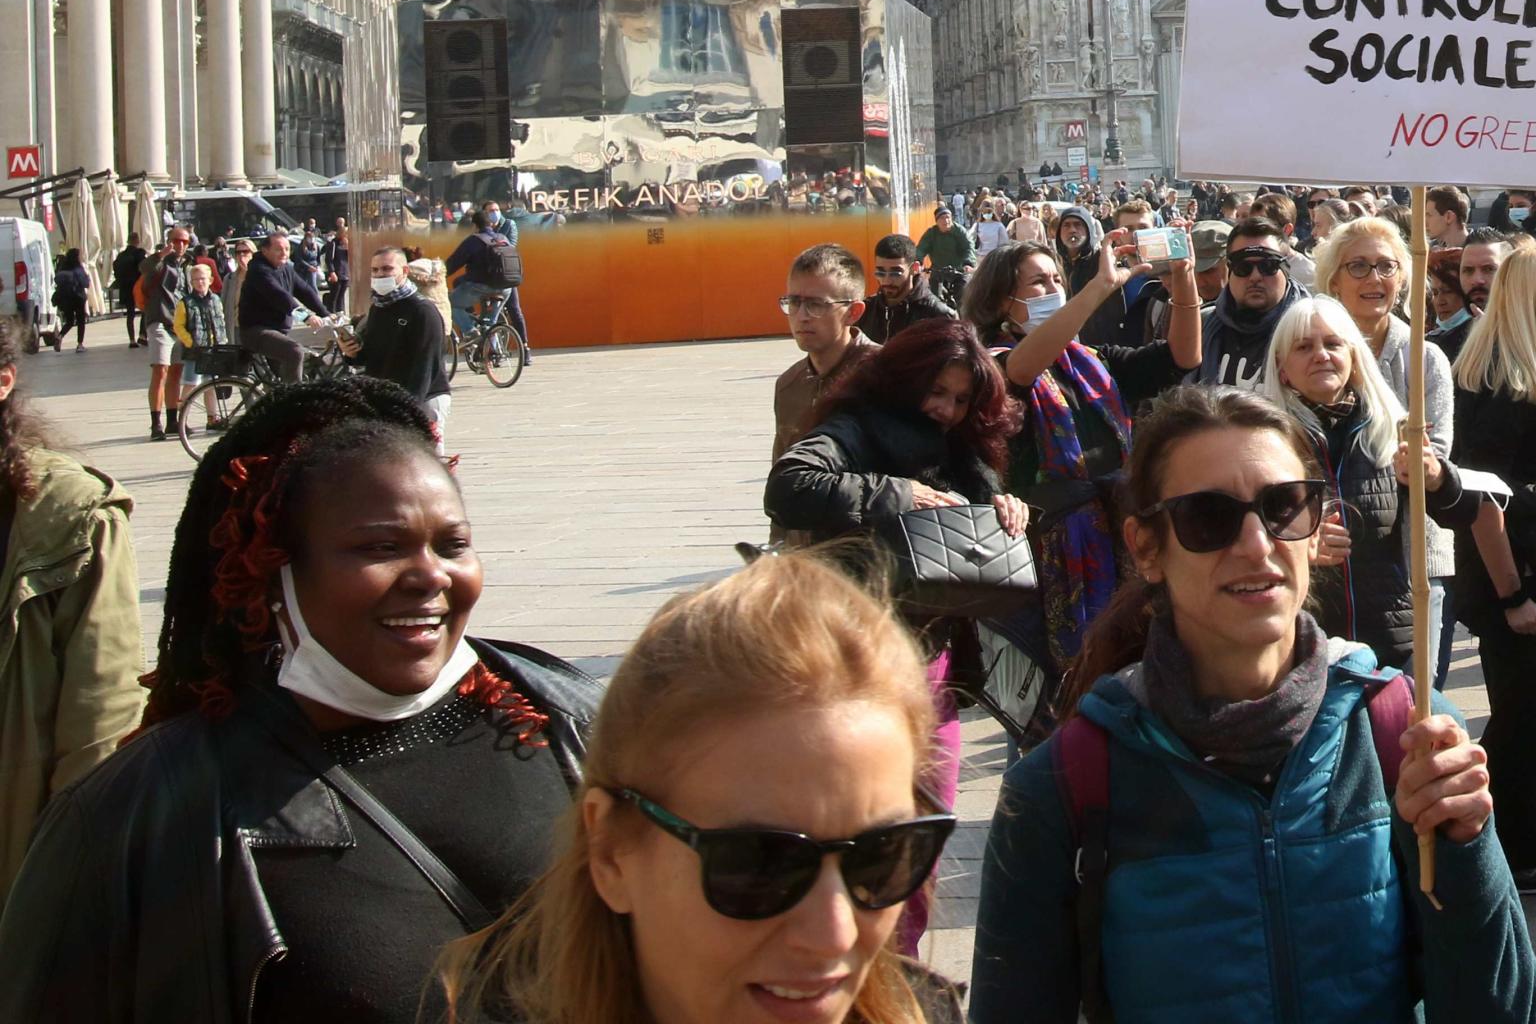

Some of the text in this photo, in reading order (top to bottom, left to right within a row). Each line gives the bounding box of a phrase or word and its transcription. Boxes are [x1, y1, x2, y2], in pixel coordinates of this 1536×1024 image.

[1067, 124, 1084, 138] M
[1391, 113, 1448, 147] NO
[11, 153, 38, 172] M
[531, 174, 769, 212] REFIK ANADOL
